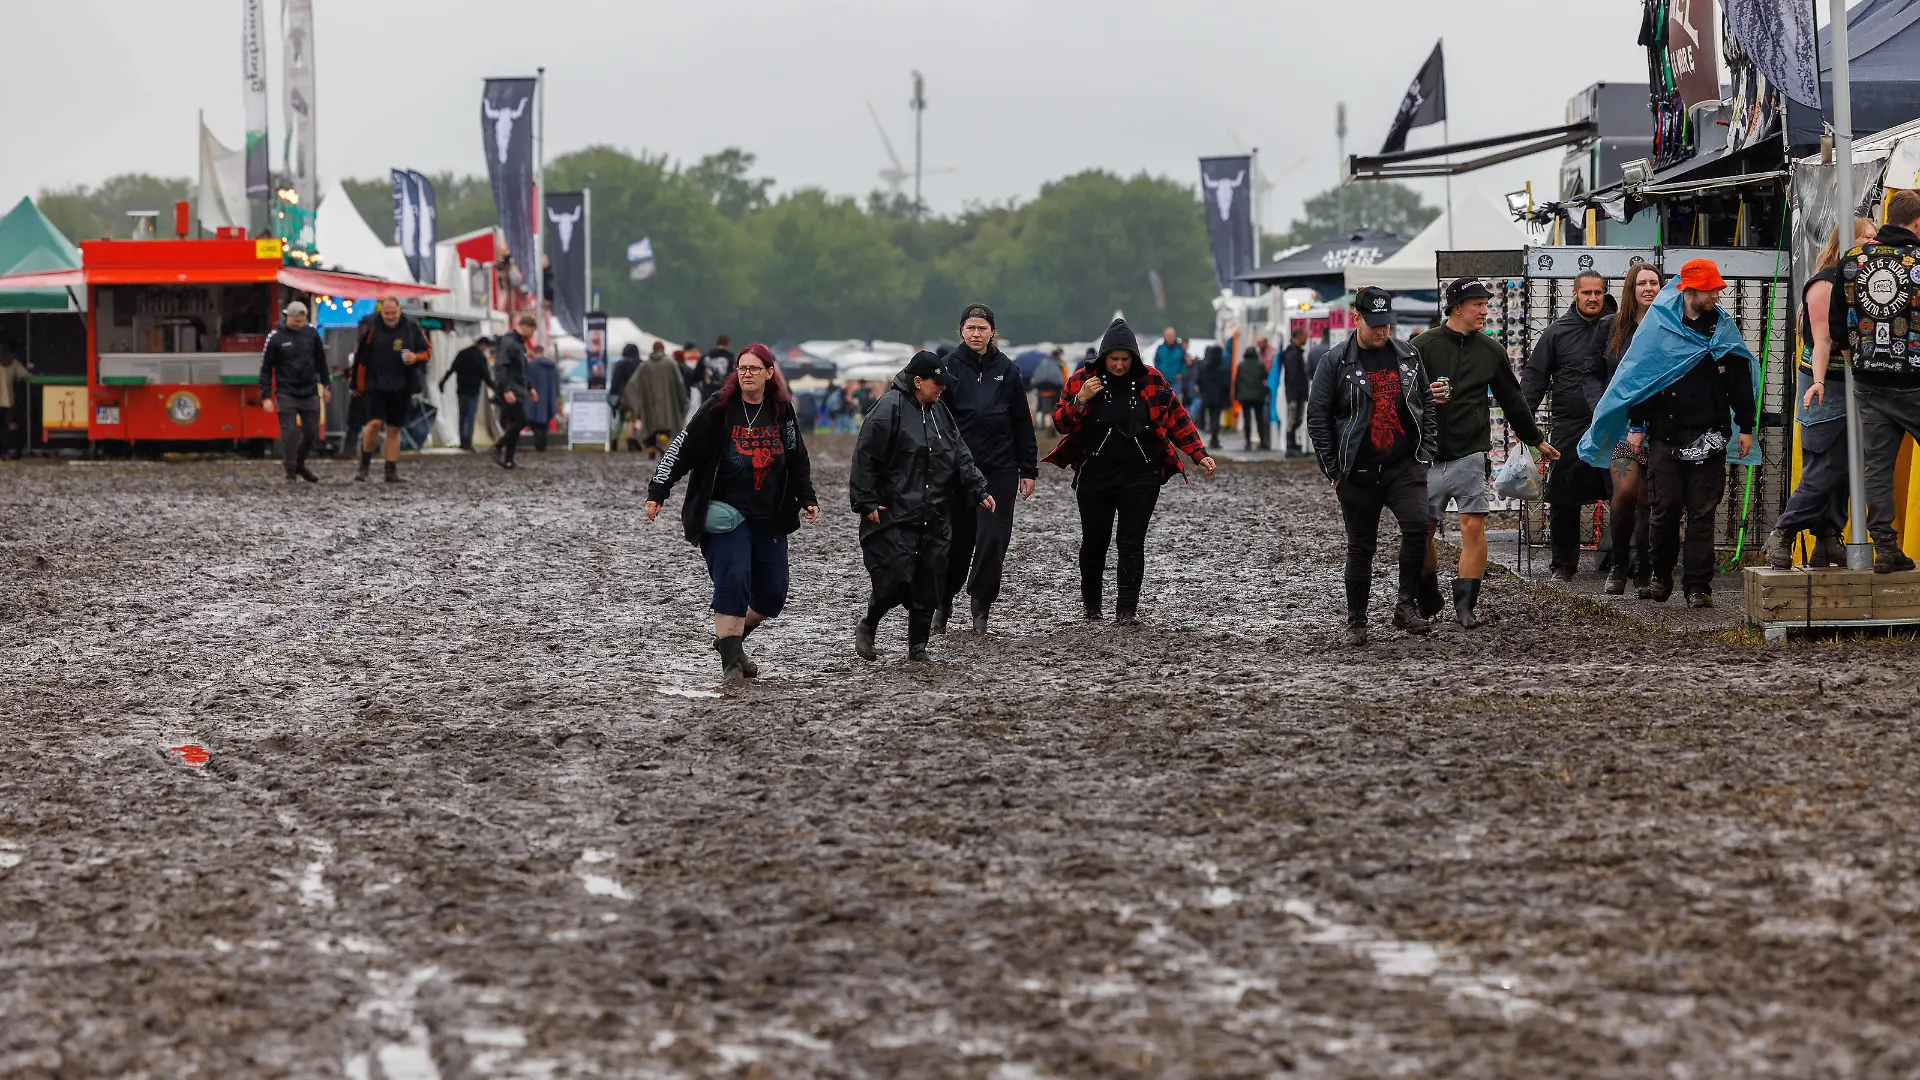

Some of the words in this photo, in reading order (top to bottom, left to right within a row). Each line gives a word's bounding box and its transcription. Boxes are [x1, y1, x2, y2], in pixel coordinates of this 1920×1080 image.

[1321, 246, 1383, 262] APFEL
[1857, 261, 1876, 285] HALLE
[1888, 259, 1909, 285] ULTRAS
[1858, 291, 1880, 316] ULTRAS
[1889, 291, 1909, 314] HALLE
